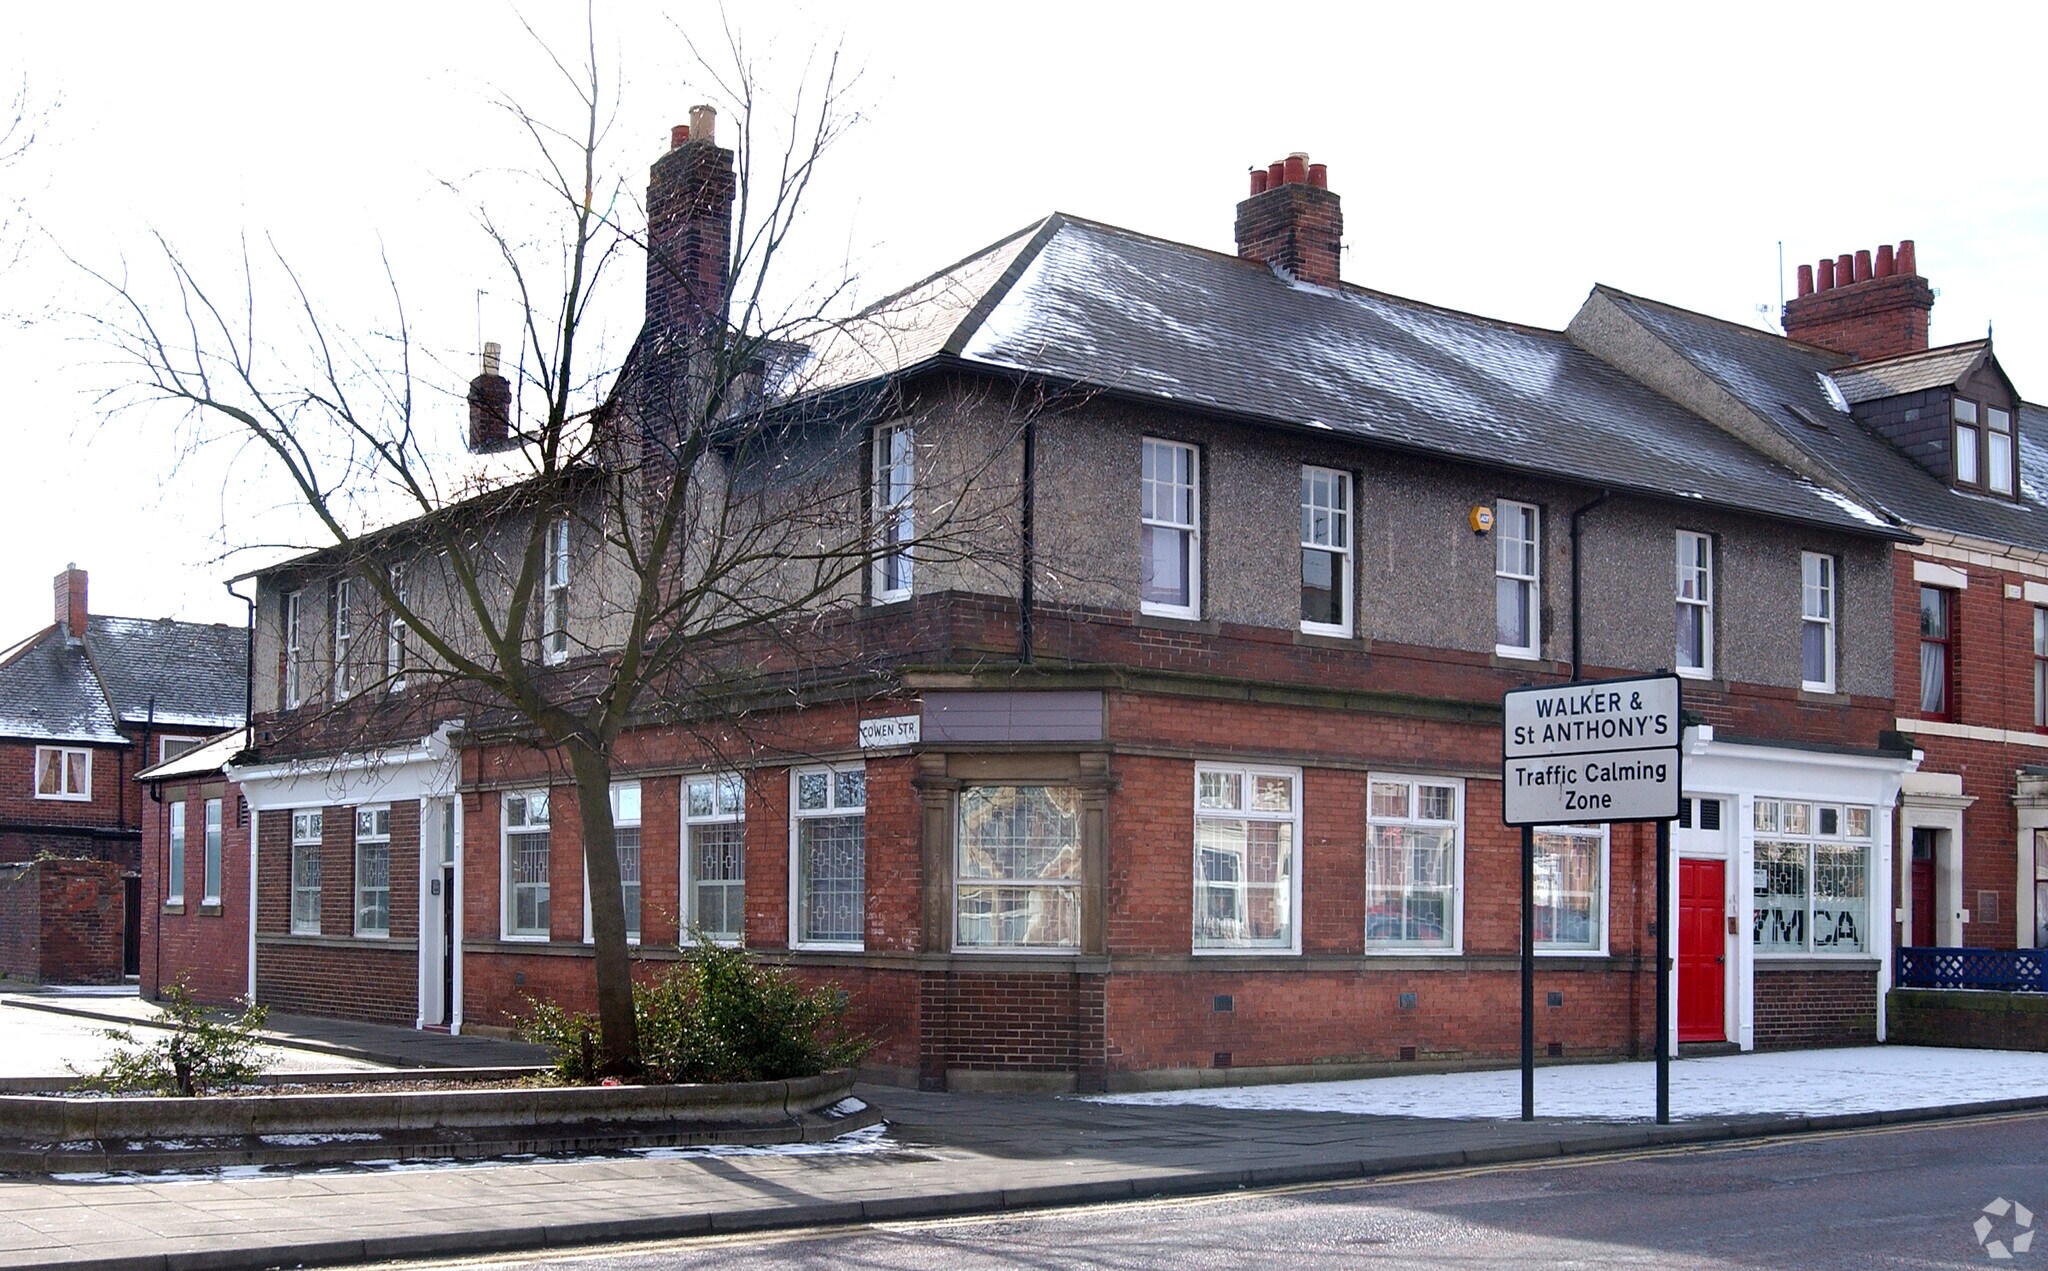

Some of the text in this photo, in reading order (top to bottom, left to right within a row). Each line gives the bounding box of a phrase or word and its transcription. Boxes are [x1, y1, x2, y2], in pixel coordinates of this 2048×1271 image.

[1536, 692, 1643, 718] WALKER &
[863, 724, 894, 738] COWEN
[1514, 714, 1668, 745] St ANTHONY'S
[1516, 761, 1667, 787] Traffic Calming
[1565, 790, 1612, 810] Zone
[1753, 908, 1859, 946] YMCA
